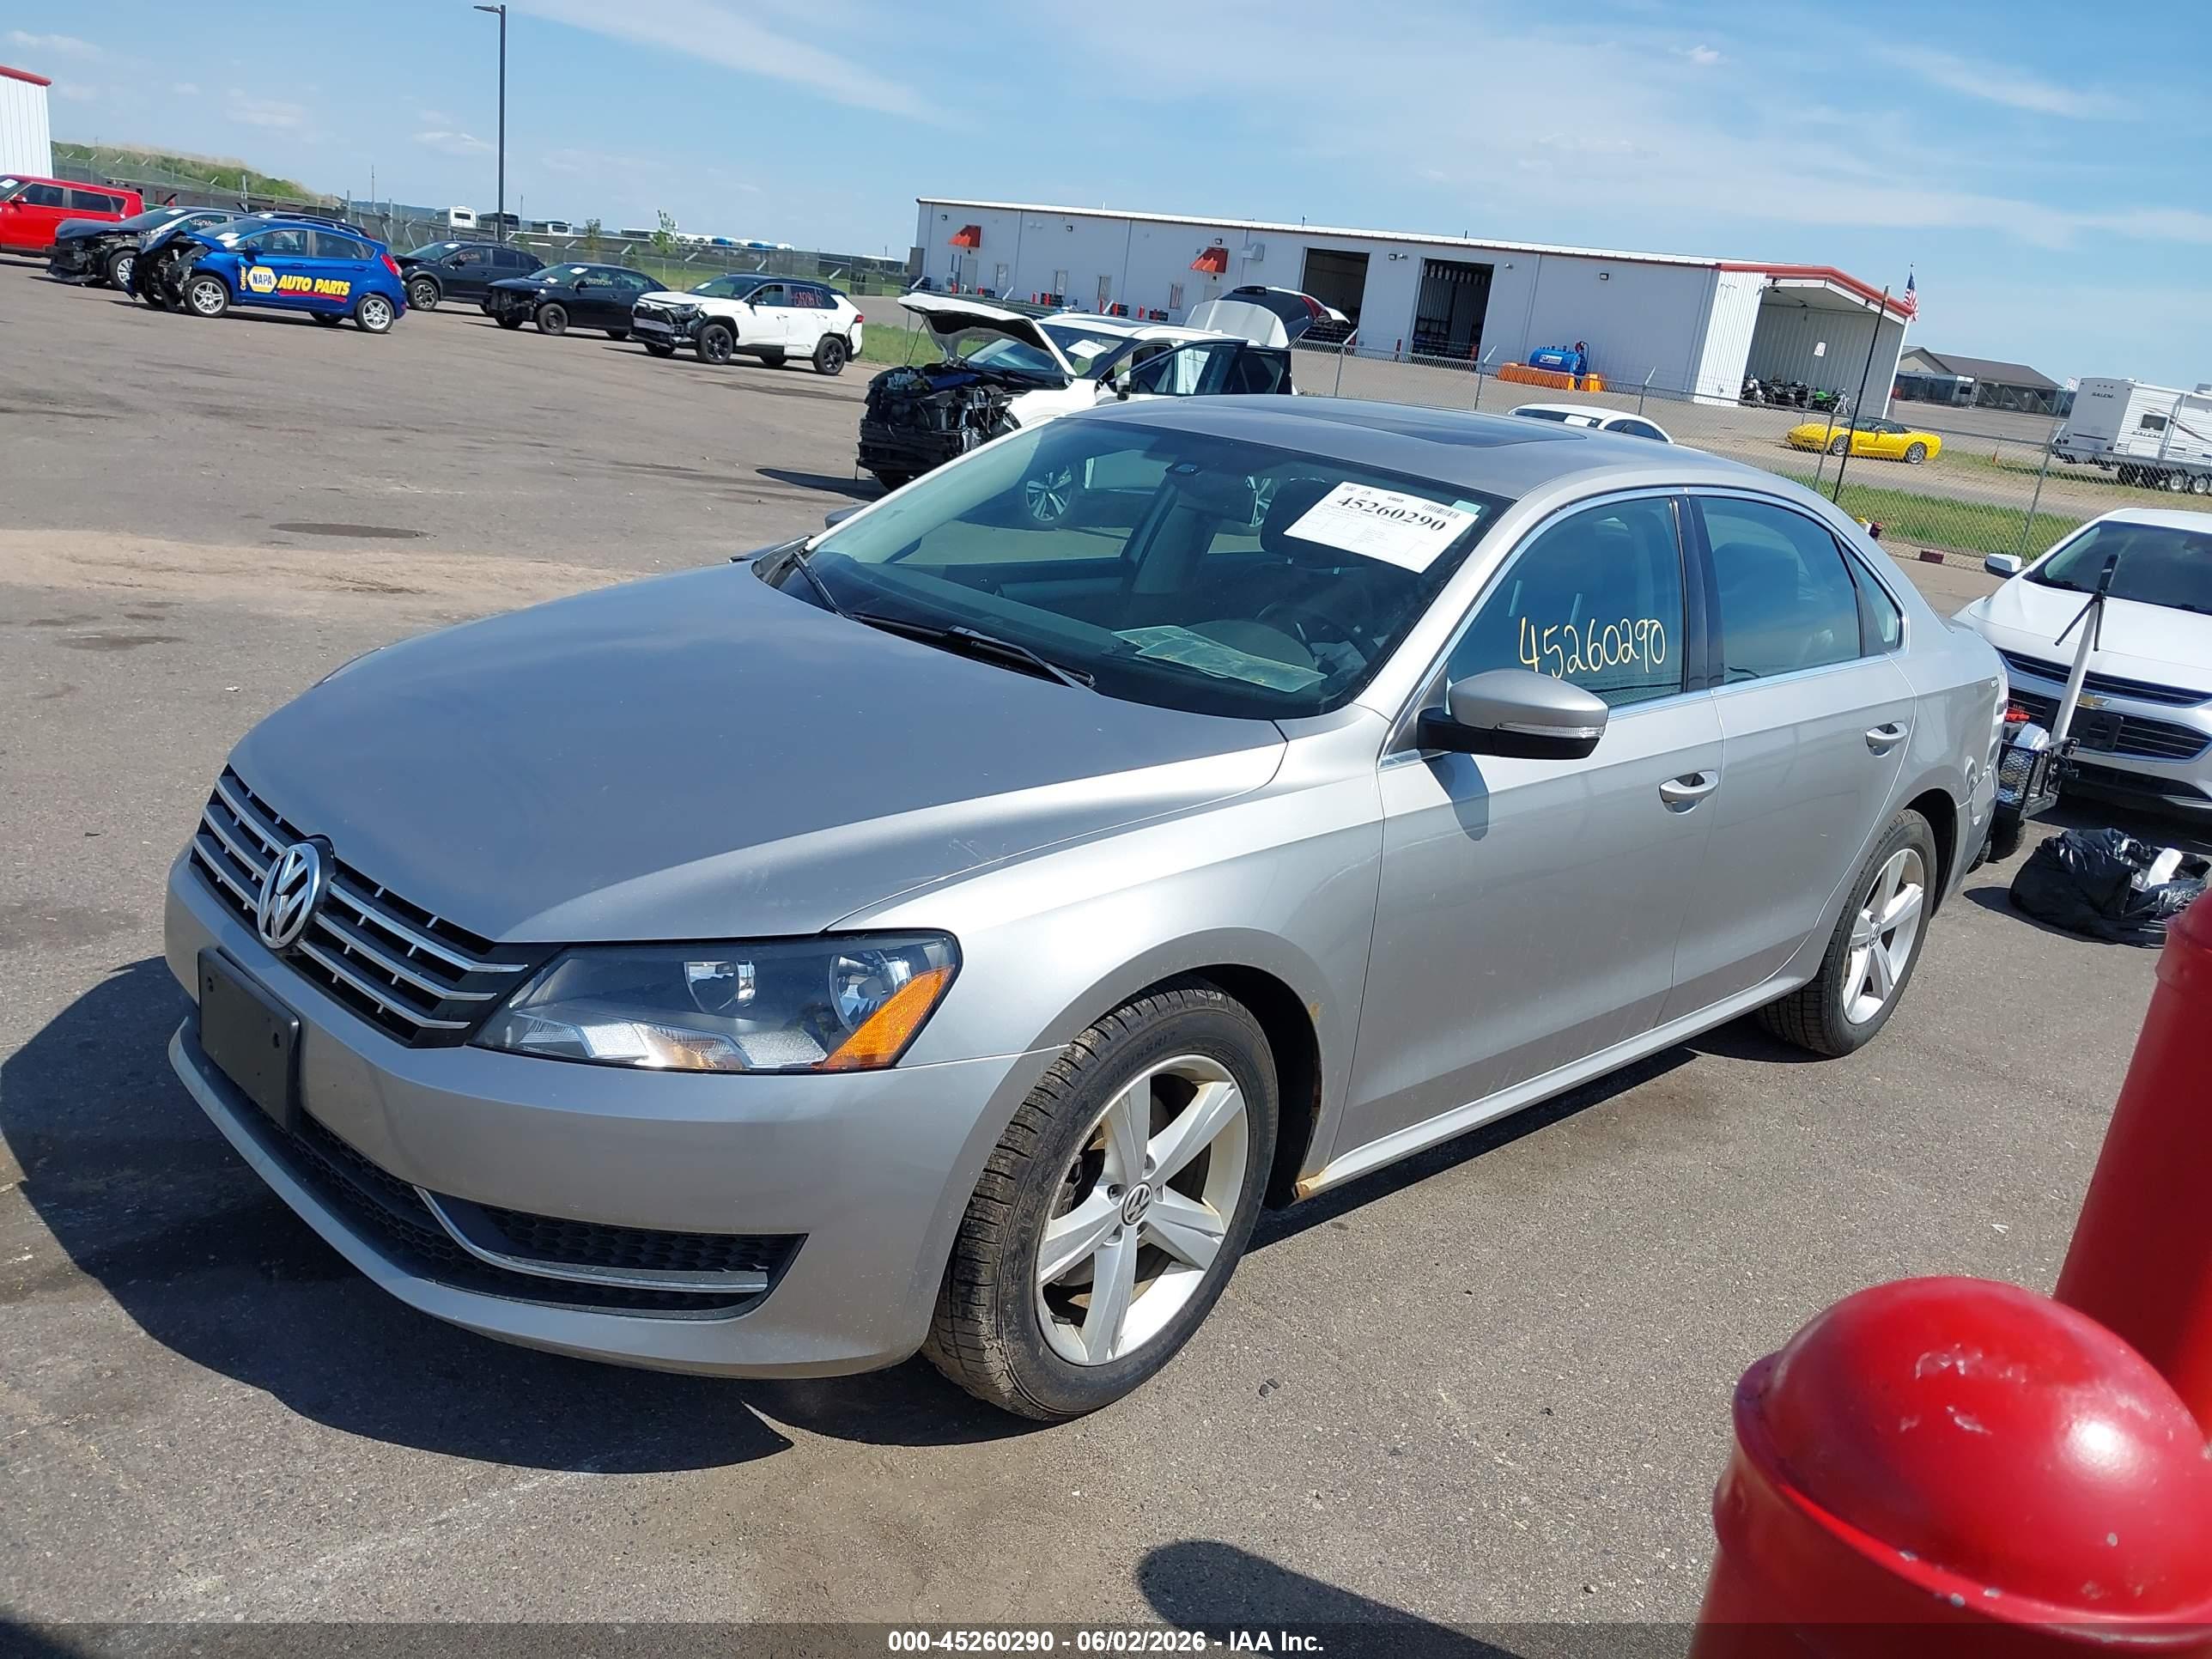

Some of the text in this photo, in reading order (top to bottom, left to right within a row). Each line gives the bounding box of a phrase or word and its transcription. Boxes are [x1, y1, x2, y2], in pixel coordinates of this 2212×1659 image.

[252, 273, 350, 296] NAPA AUTO PARTS
[1337, 496, 1446, 532] 45260290
[1518, 617, 1666, 678] 45260290
